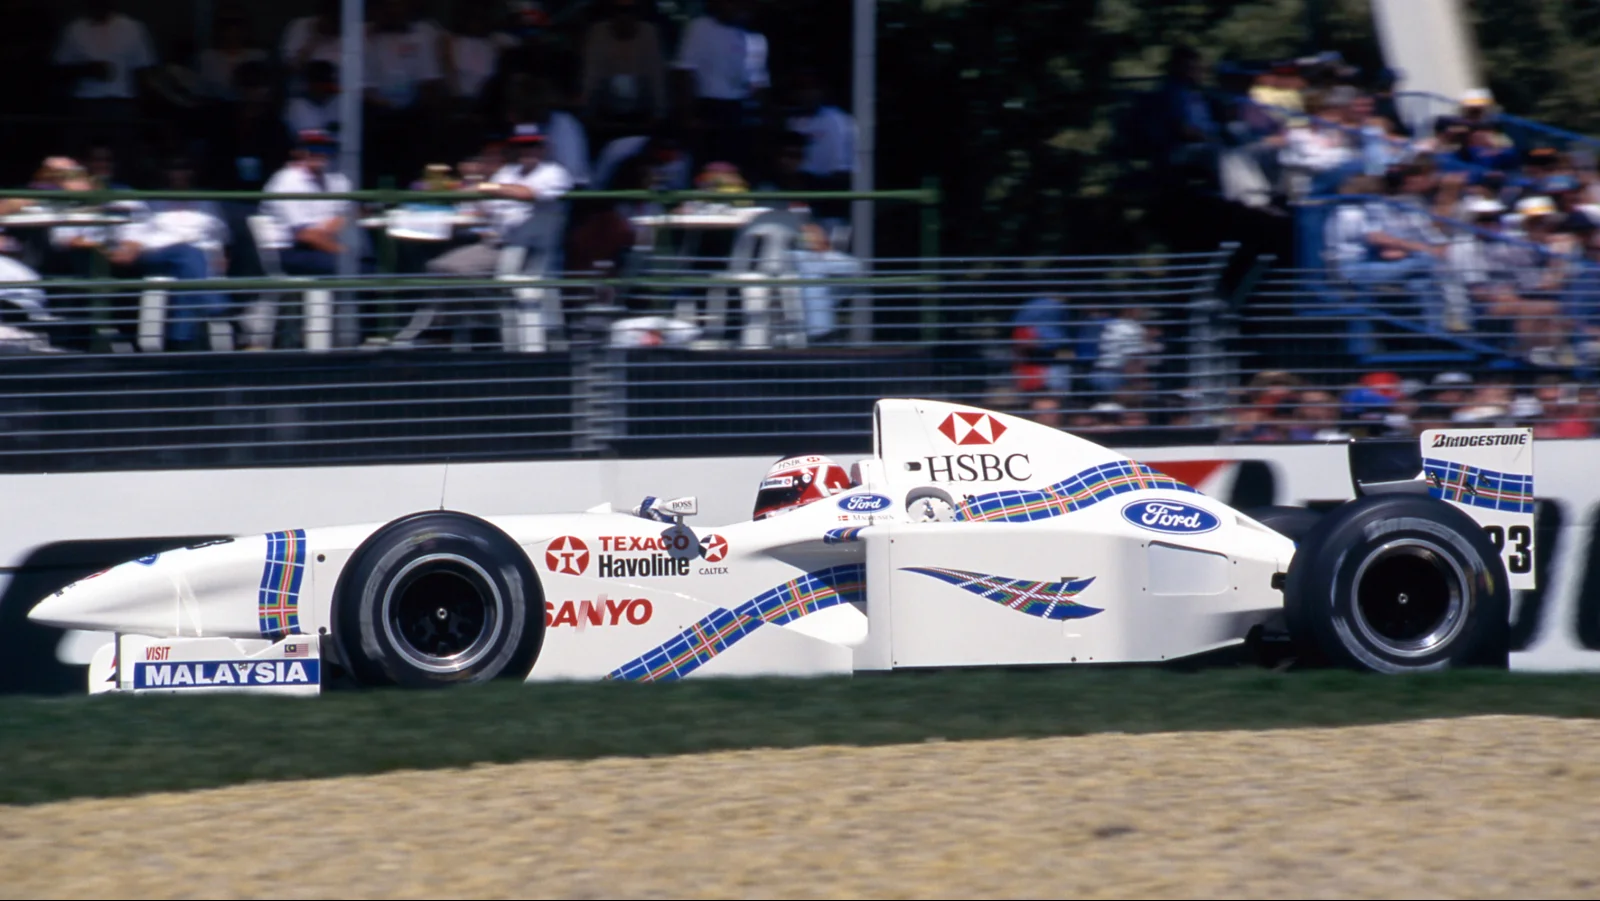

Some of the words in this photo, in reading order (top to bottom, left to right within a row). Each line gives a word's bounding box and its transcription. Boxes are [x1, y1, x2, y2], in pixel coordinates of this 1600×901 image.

[1432, 433, 1529, 448] BRIDGESTONE
[924, 452, 1033, 483] HSBC
[672, 500, 693, 510] BOSS
[847, 495, 882, 511] Ford
[1141, 503, 1201, 529] Ford
[598, 535, 690, 552] TEXACO
[598, 553, 690, 578] Havoline
[698, 567, 729, 575] CALTEX
[145, 646, 171, 661] VISIT
[145, 661, 309, 687] MALAYSIA
